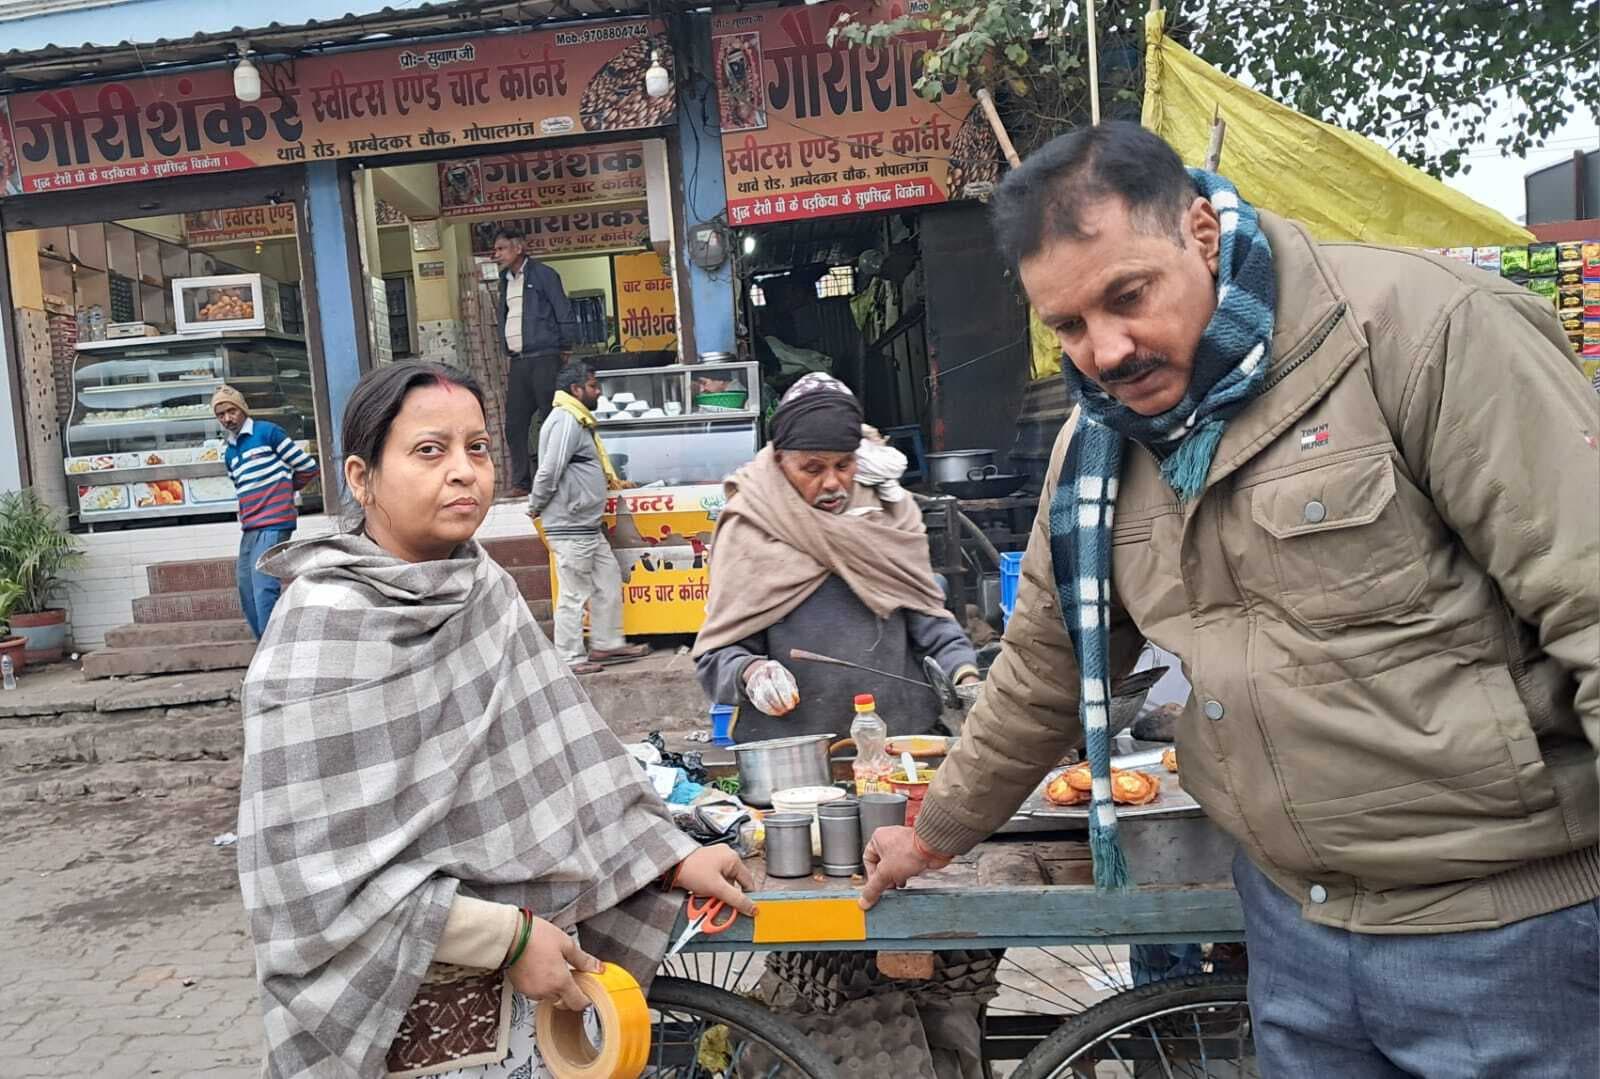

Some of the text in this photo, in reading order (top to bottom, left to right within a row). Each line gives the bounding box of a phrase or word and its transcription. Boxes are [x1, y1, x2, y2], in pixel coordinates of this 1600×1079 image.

[391, 72, 441, 111] एण्ड
[447, 67, 490, 106] चाट
[497, 48, 567, 101] कॉर्नर
[16, 79, 303, 166] गौरीशंकर
[462, 117, 535, 142] गोपालगंज
[798, 137, 841, 166] एण्ड
[847, 131, 884, 160] चाट
[89, 168, 98, 182] के
[140, 162, 149, 176] के
[875, 158, 928, 177] गोपालगंज
[789, 195, 799, 211] के
[841, 188, 852, 206] के
[629, 584, 651, 604] एण्ड
[655, 584, 674, 602] चाट
